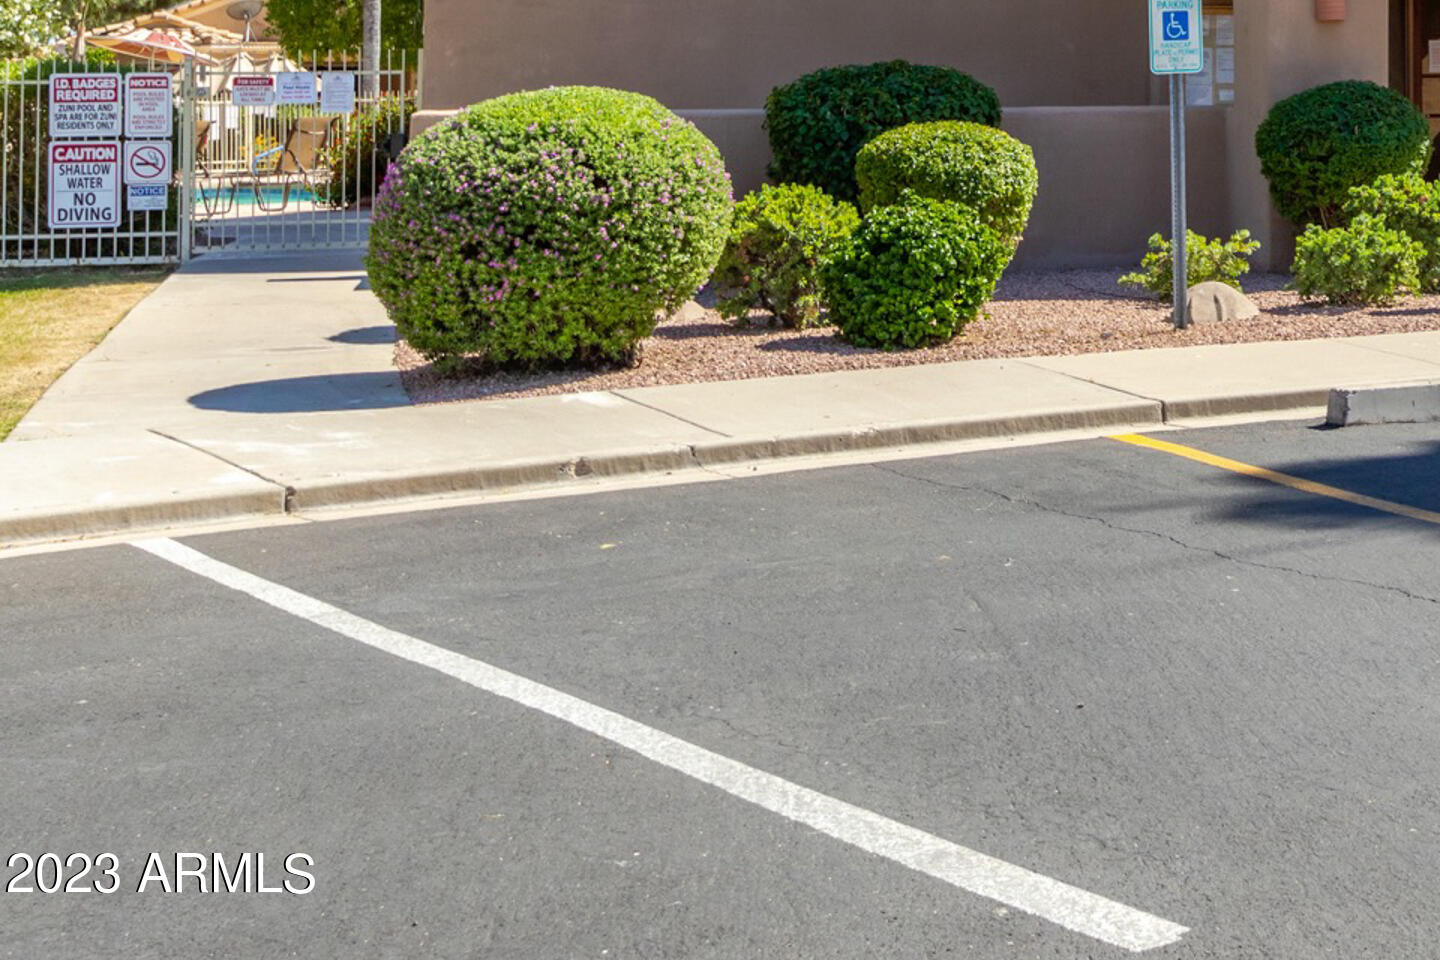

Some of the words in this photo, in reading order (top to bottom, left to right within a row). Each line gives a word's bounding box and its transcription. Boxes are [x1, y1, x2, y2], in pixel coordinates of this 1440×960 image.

[1157, 0, 1193, 9] PARKING
[55, 79, 71, 89] I.D.
[72, 78, 116, 89] BADGES
[130, 78, 168, 87] NOTICE
[56, 90, 115, 101] REQUIRED
[77, 104, 95, 112] POOL
[55, 113, 67, 121] SPA
[69, 113, 82, 121] ARE
[57, 121, 95, 129] RESIDENTS
[96, 121, 114, 129] ONLY
[55, 147, 115, 160] CAUTION
[59, 164, 111, 176] SHALLOW
[67, 177, 103, 189] WATER
[130, 187, 165, 195] NOTICE
[74, 192, 96, 206] NO
[58, 207, 112, 221] DIVING
